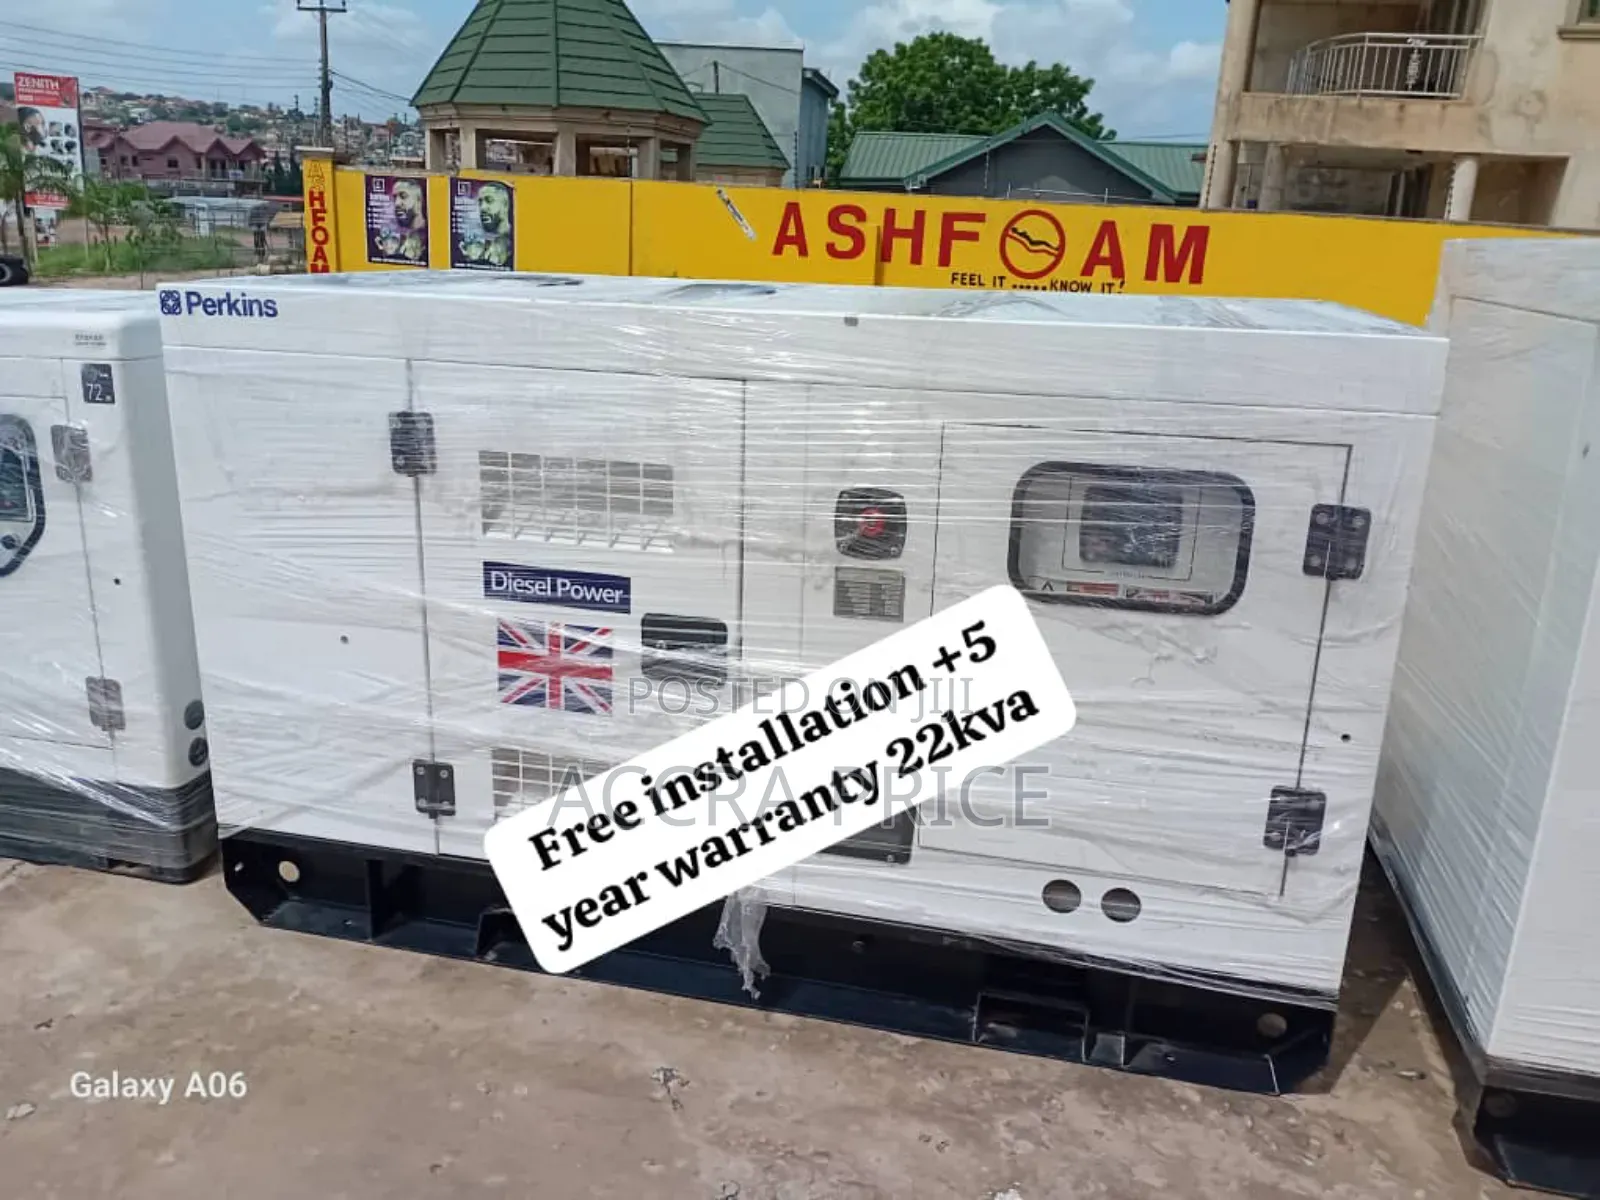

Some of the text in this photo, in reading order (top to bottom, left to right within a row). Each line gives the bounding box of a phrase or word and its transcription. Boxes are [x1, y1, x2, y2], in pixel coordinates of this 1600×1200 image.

[950, 272, 985, 287] FEEL
[992, 275, 1007, 288] IT
[184, 291, 278, 318] Perkins
[86, 382, 104, 401] 72
[490, 570, 624, 604] Diesel Power
